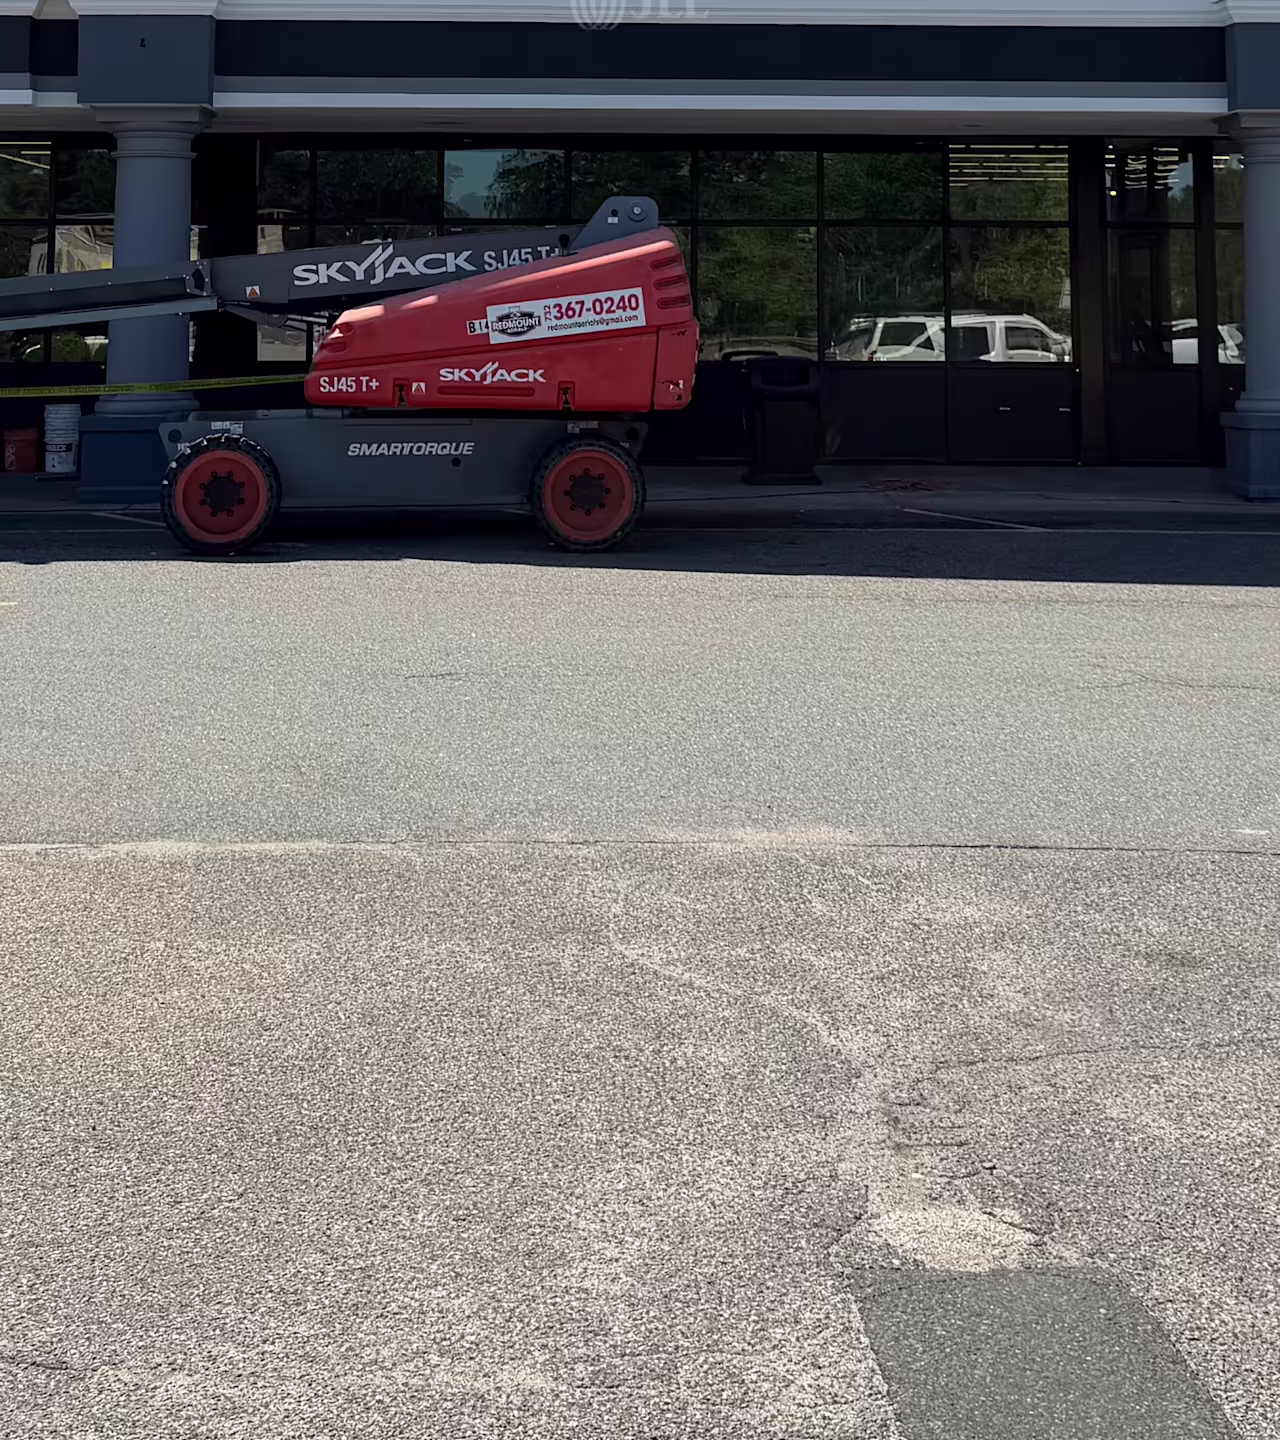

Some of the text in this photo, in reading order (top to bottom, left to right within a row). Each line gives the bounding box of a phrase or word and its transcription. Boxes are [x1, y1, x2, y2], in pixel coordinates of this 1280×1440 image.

[293, 243, 477, 285] SKYJACK
[483, 248, 534, 272] SJ45
[553, 293, 640, 320] 367-0240
[492, 317, 540, 331] REDMOUNT
[320, 376, 356, 392] SJ45
[360, 376, 380, 391] T+
[439, 361, 546, 384] SKYJACK
